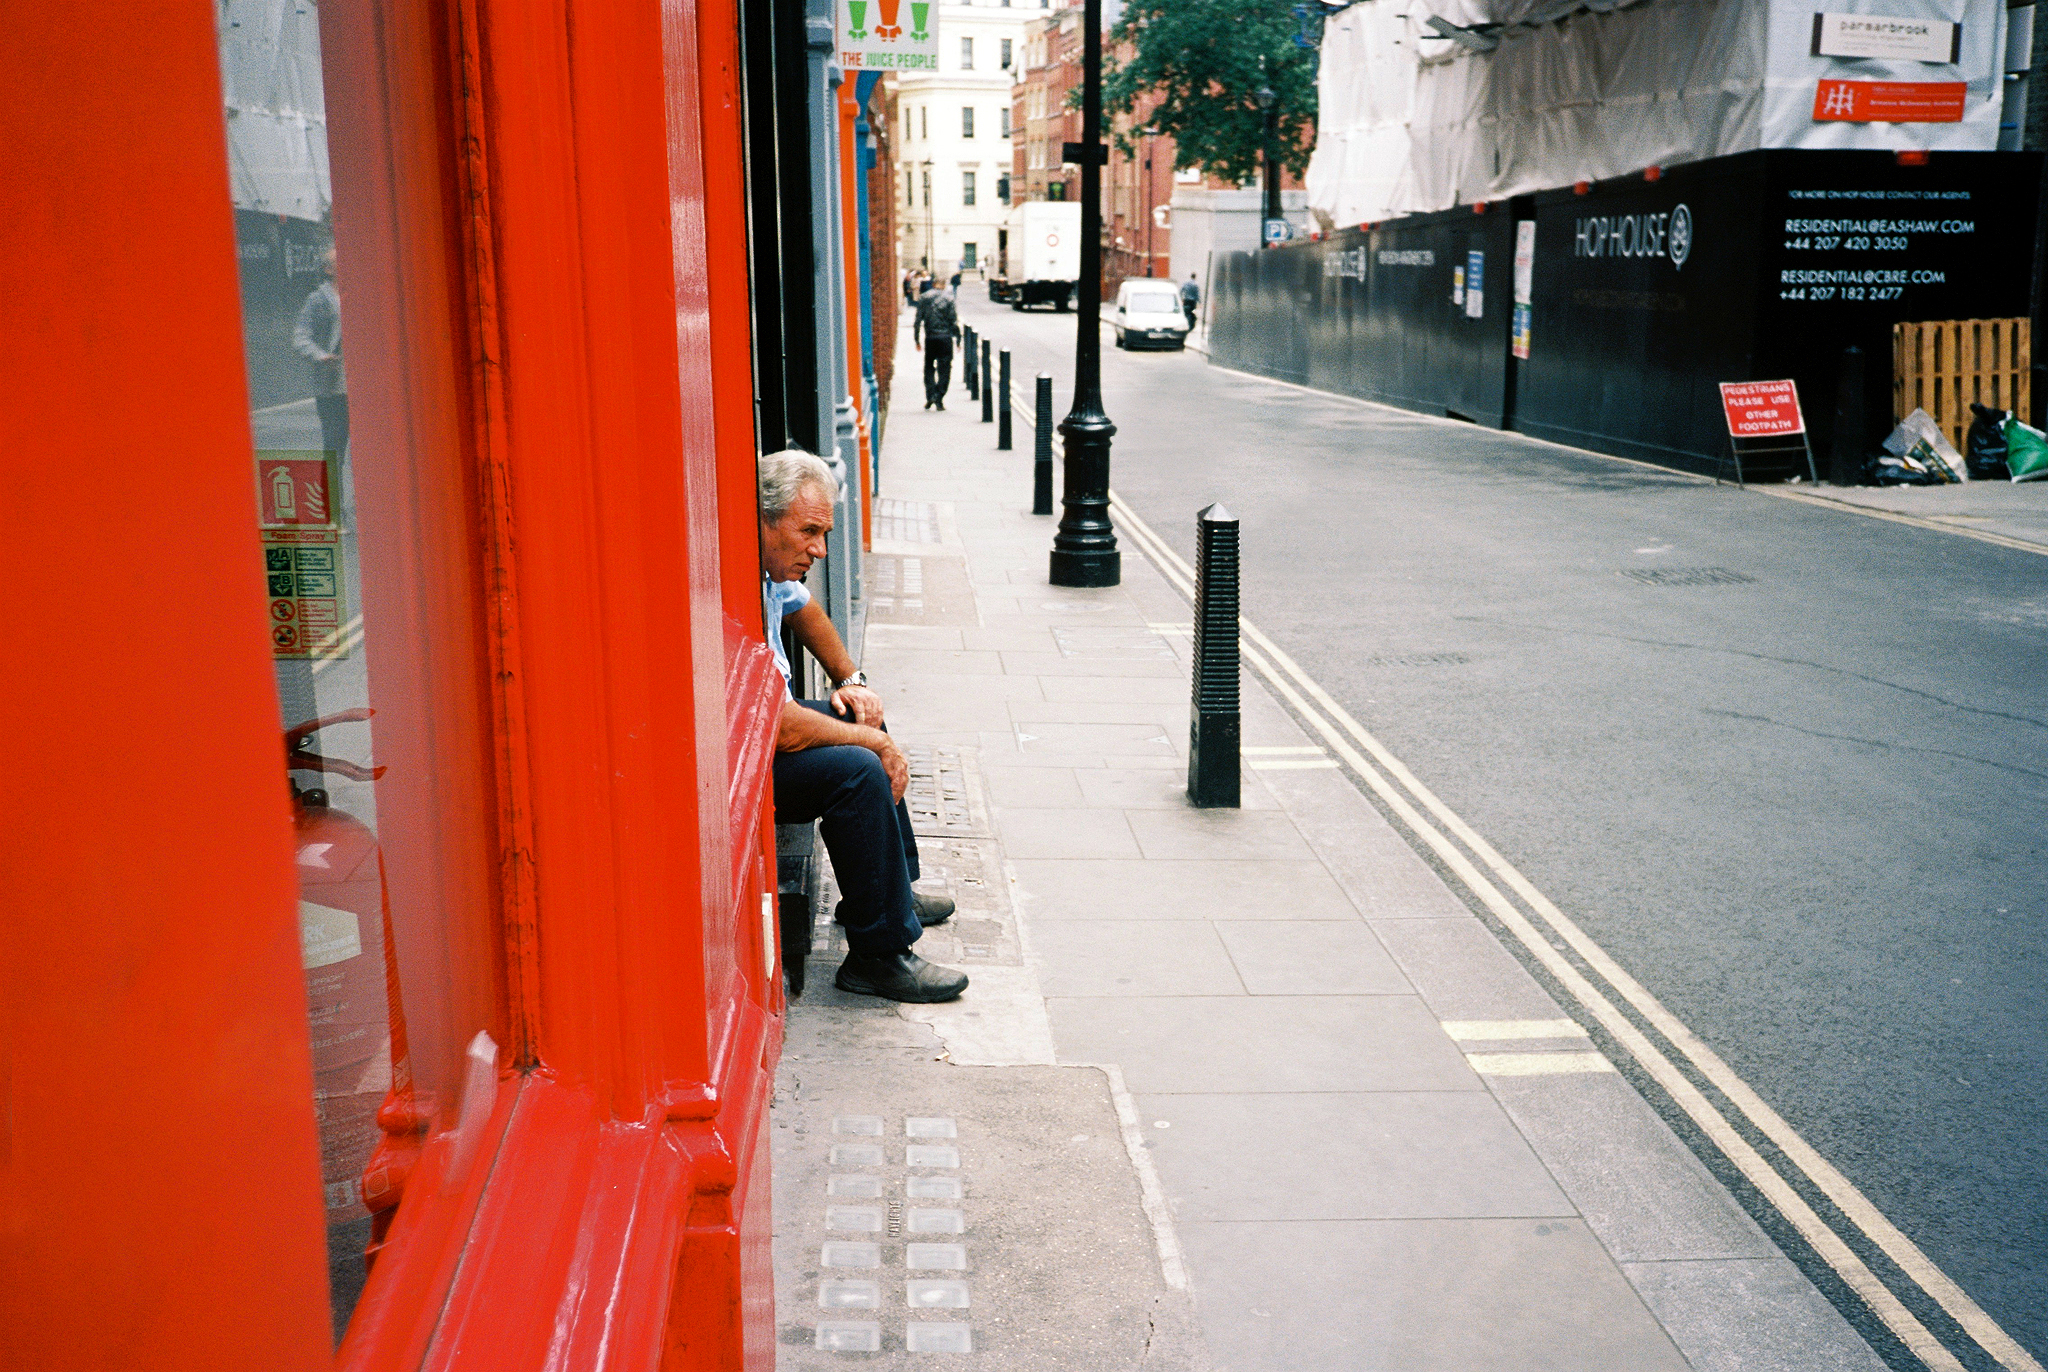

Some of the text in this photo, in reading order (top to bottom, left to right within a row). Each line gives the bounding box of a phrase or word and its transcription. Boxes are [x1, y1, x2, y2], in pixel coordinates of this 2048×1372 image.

[842, 51, 936, 69] THE JUICE PEOPLE
[1784, 218, 1975, 234] RESIDENTIAL@EASHAW.COM
[1575, 212, 1668, 258] HOP HOUSE
[1783, 236, 1909, 251] +44 207 420 3050
[1780, 269, 1946, 285] RESIDENTIAL@CBRE.COM
[1779, 286, 1904, 301] +44 207 182 2477
[1725, 383, 1790, 395] PEDESTRIANS
[1728, 395, 1790, 406] PLEASE USE
[1745, 410, 1778, 420] OTHER
[1738, 420, 1791, 431] FOOTPATH
[271, 530, 326, 541] Foam Spray
